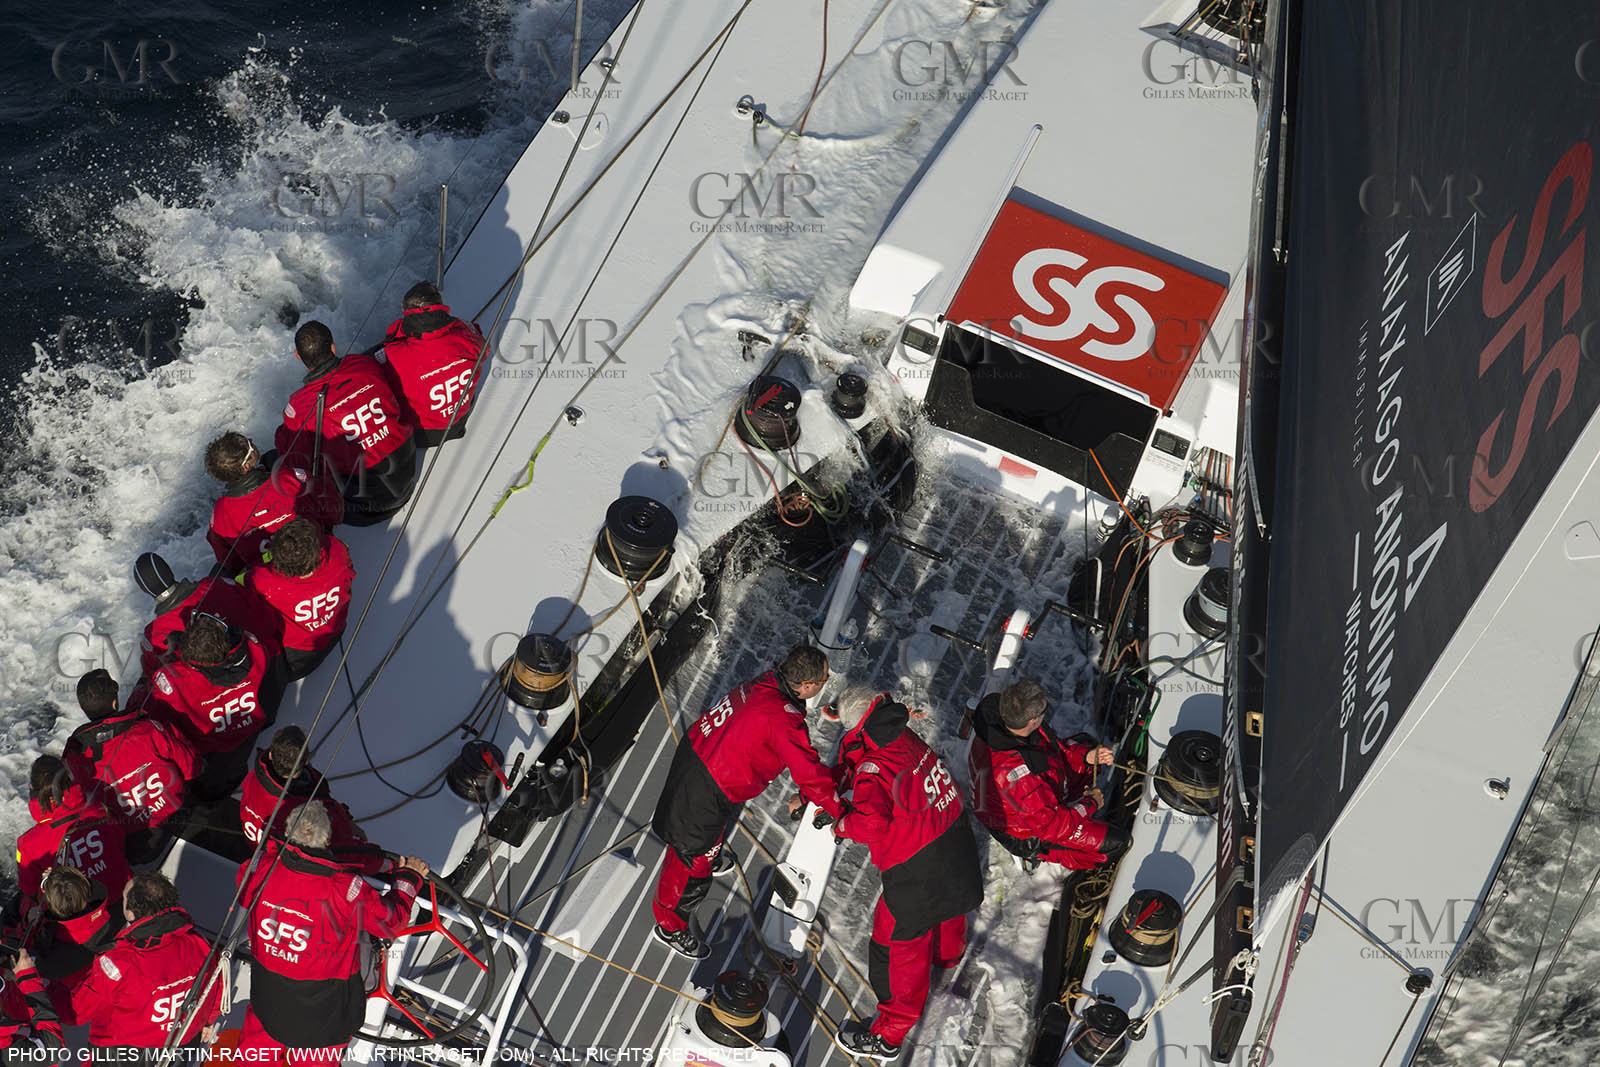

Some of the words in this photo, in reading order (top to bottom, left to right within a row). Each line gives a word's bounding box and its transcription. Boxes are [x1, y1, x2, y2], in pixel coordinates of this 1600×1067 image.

[1469, 140, 1593, 513] SFS
[1372, 230, 1410, 486] ANAXAGO
[429, 369, 473, 411] SFS
[1352, 319, 1369, 469] IMMOBILIER
[341, 397, 387, 441] SFS
[358, 425, 390, 450] TEAM
[294, 586, 340, 622] SFS
[1360, 485, 1403, 755] ANONIMO
[1339, 591, 1362, 729] WATCHES
[209, 692, 256, 733] SFS
[117, 772, 164, 817] SFS
[923, 758, 952, 805] SFS
[935, 785, 958, 812] TEAM
[136, 796, 166, 823] TEAM
[257, 917, 310, 952] SFS
[264, 942, 299, 963] TEAM
